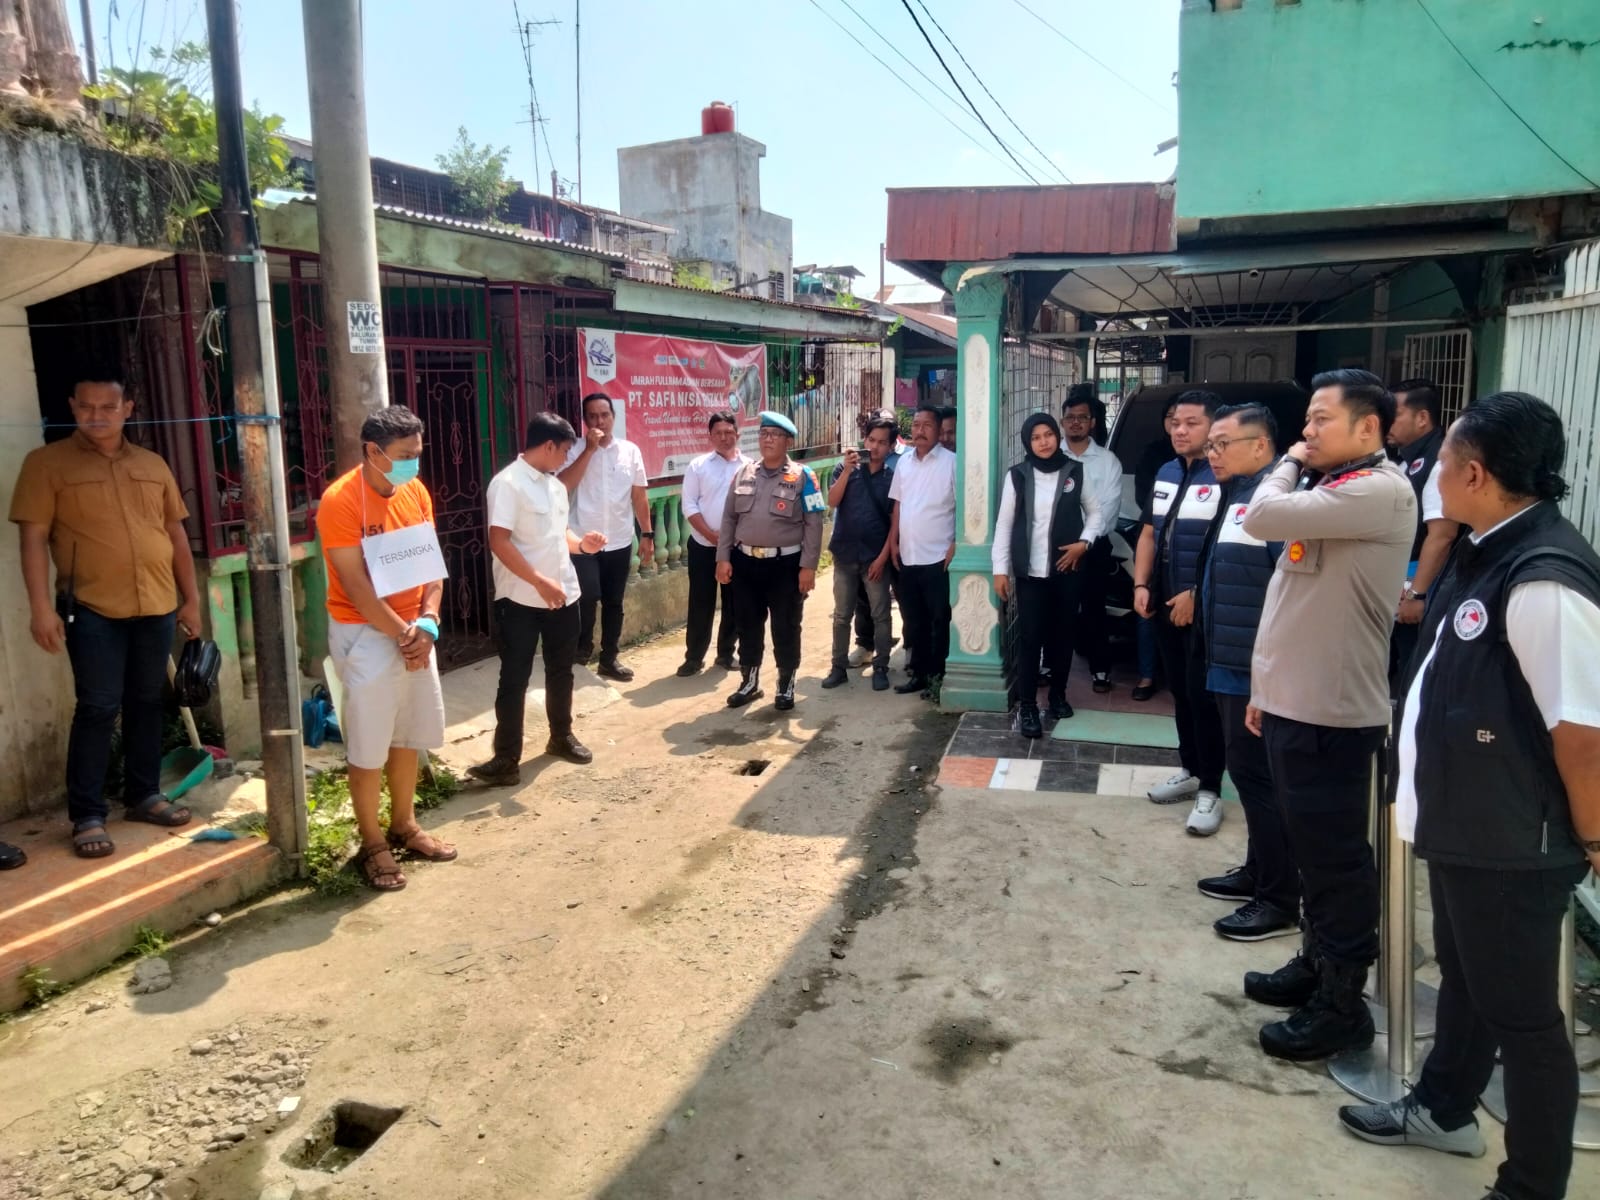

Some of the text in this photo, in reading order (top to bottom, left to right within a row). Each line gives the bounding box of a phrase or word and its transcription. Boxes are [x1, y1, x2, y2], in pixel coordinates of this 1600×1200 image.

[350, 311, 381, 326] WC
[628, 391, 646, 408] PT.
[648, 391, 676, 407] SAFA
[677, 391, 703, 407] NISA
[378, 544, 434, 566] TERSANGKA
